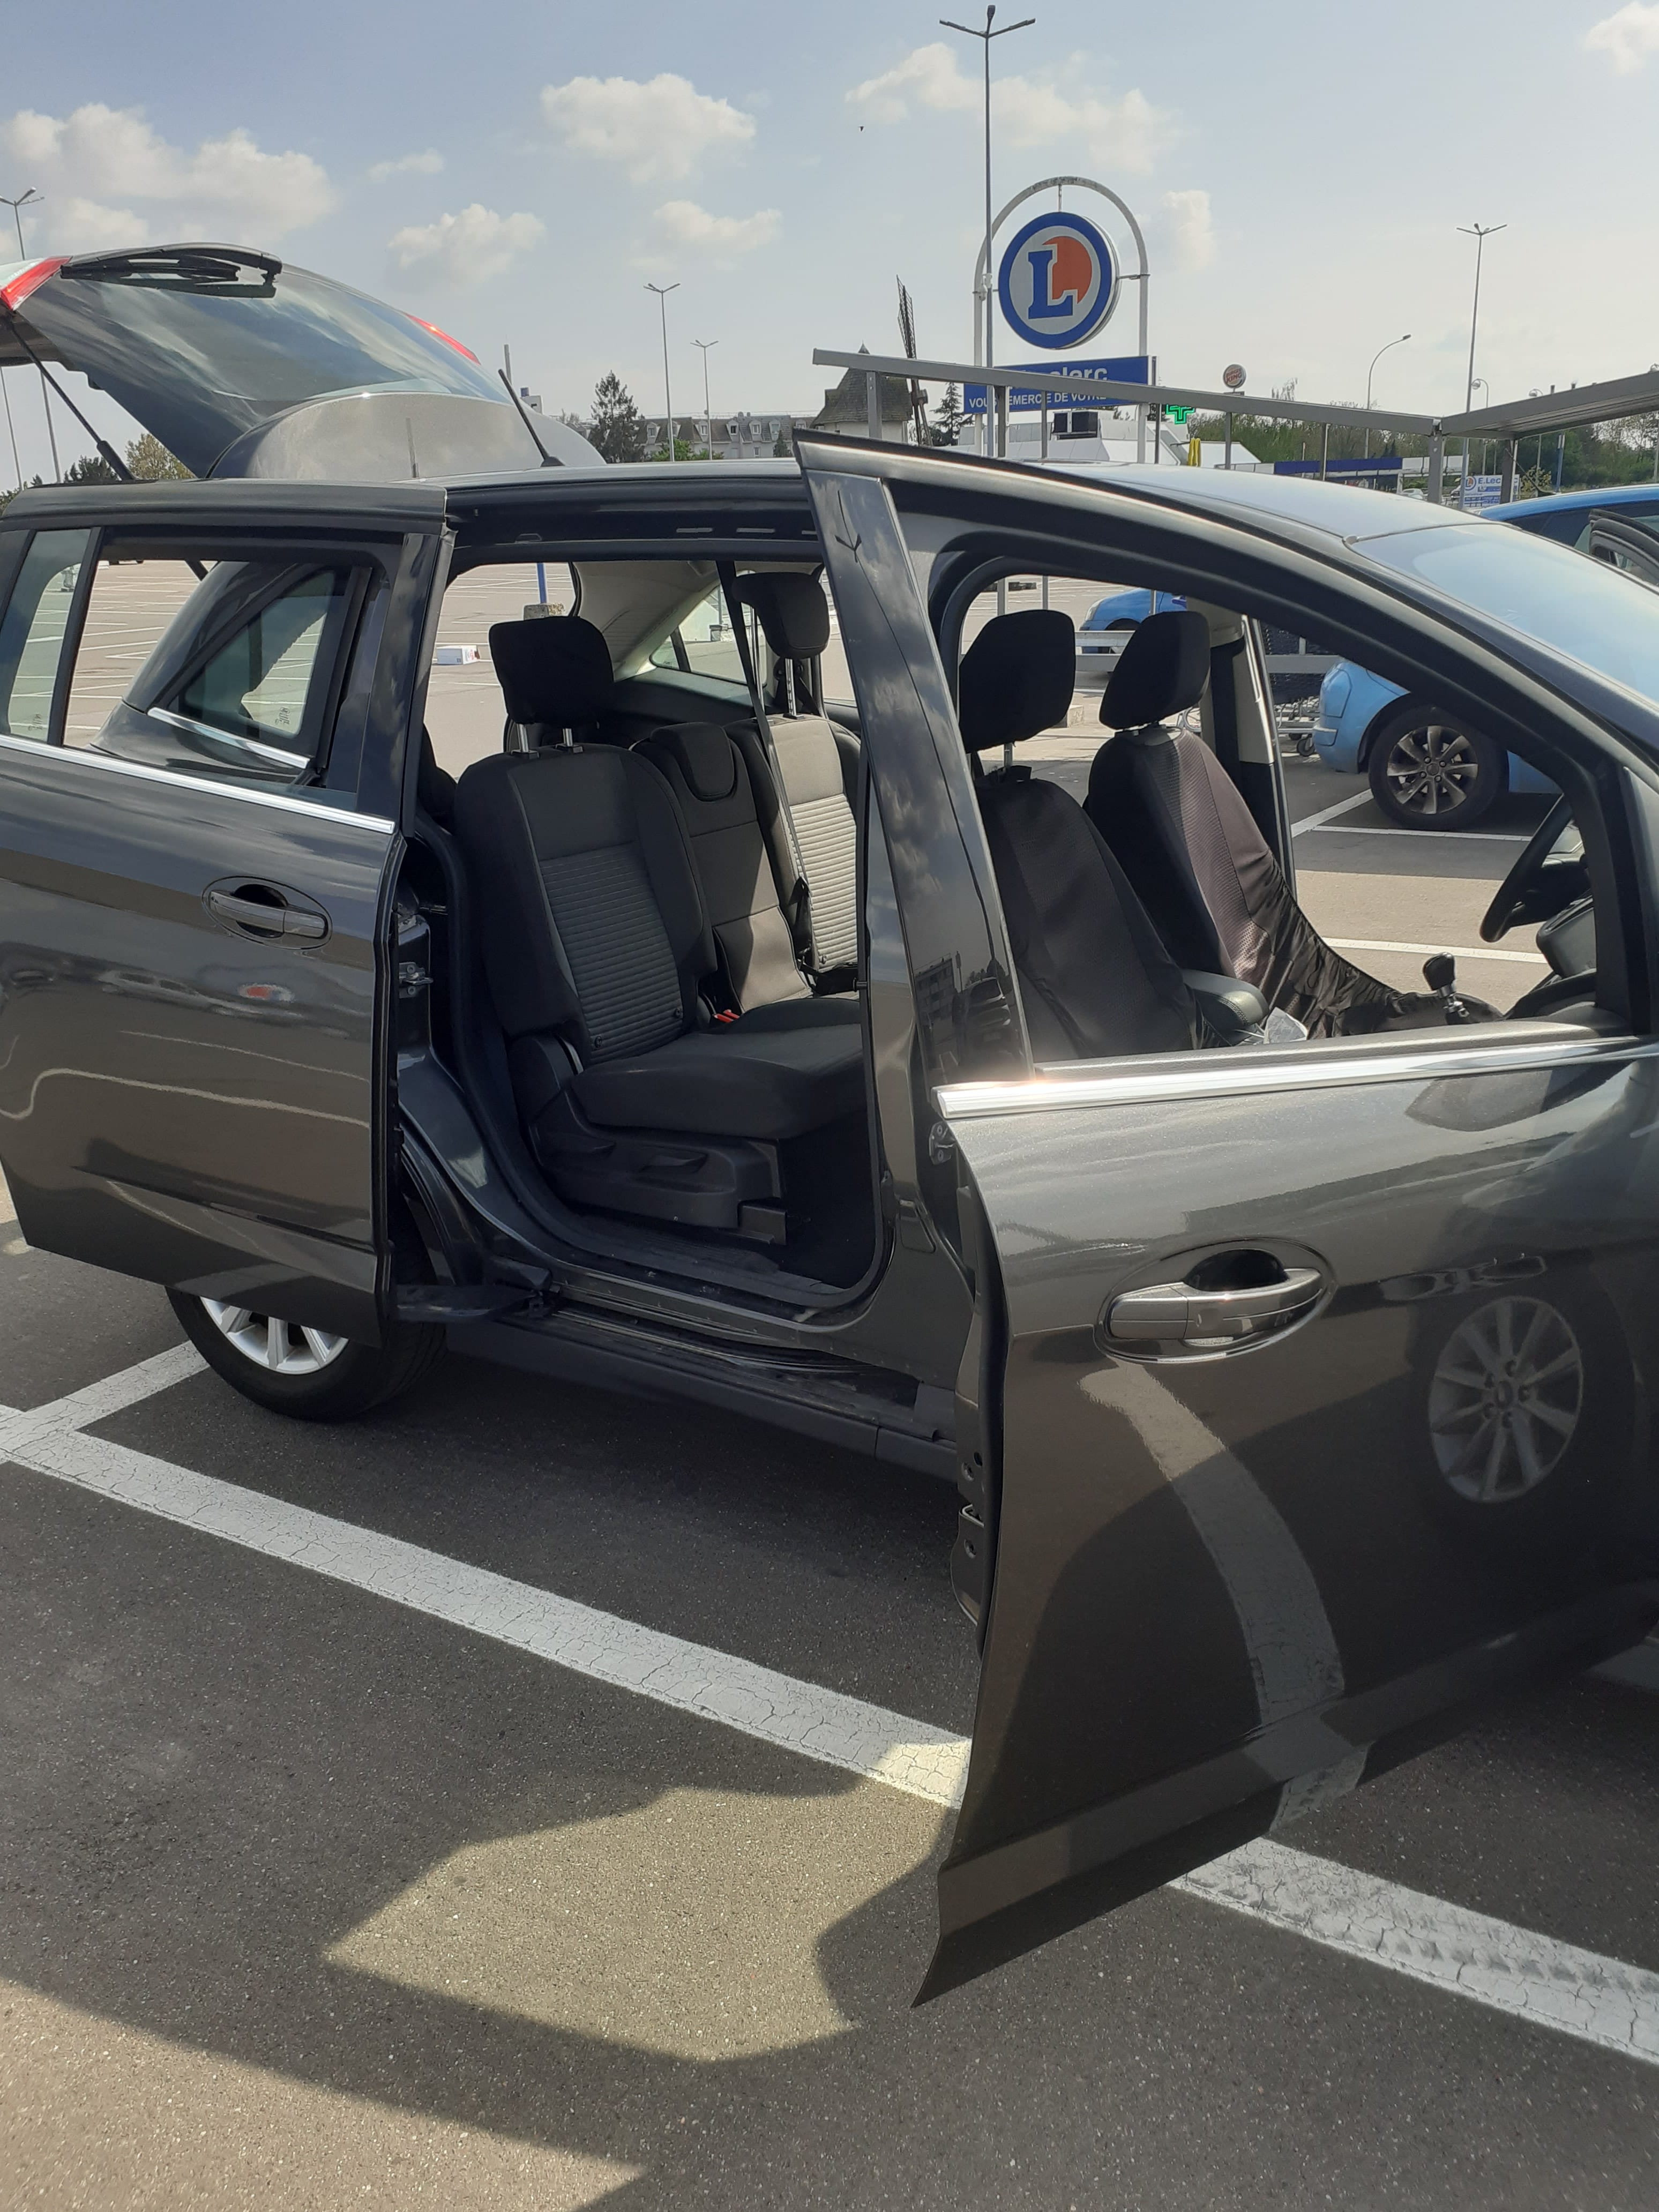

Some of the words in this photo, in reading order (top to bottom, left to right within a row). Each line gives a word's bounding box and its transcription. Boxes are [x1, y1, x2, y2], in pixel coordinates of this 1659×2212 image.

[1028, 250, 1073, 319] L
[1008, 393, 1052, 405] EMERCE
[1055, 392, 1068, 402] DE
